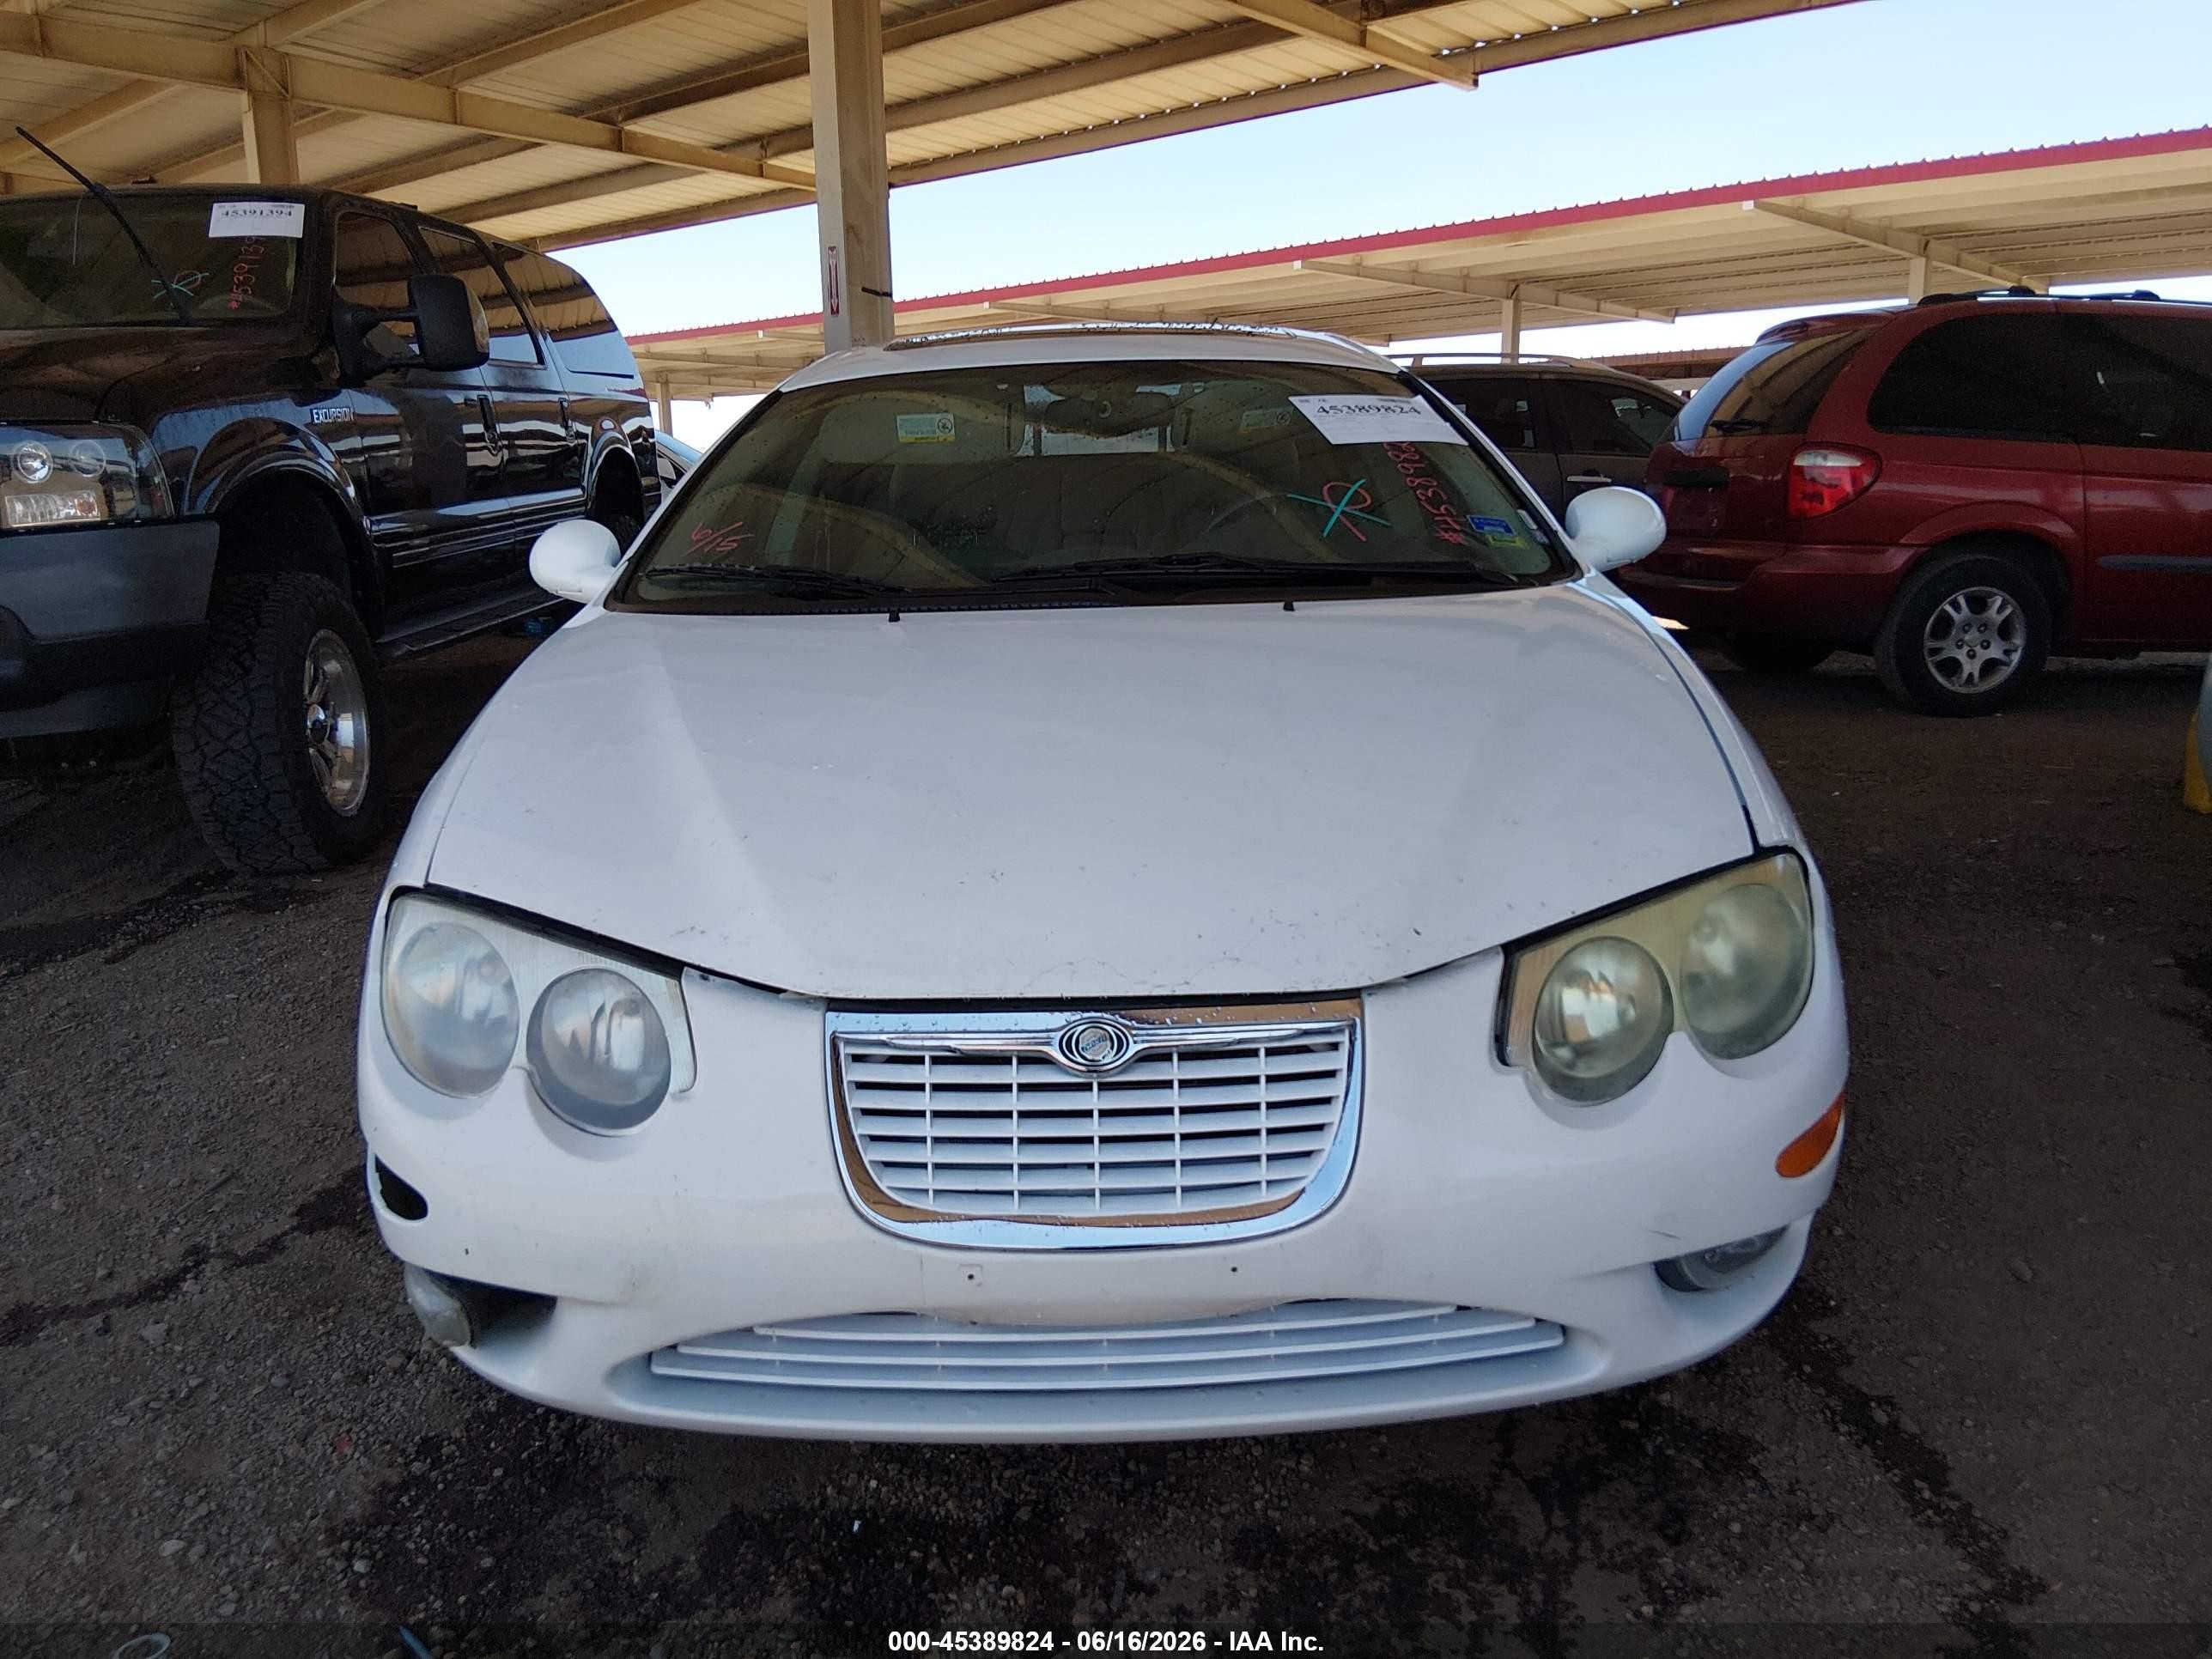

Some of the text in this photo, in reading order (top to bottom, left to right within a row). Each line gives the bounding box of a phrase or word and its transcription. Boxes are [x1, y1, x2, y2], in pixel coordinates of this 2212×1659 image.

[222, 209, 292, 217] 45391394
[312, 407, 355, 423] EXCURSION
[1316, 404, 1421, 416] 45389824
